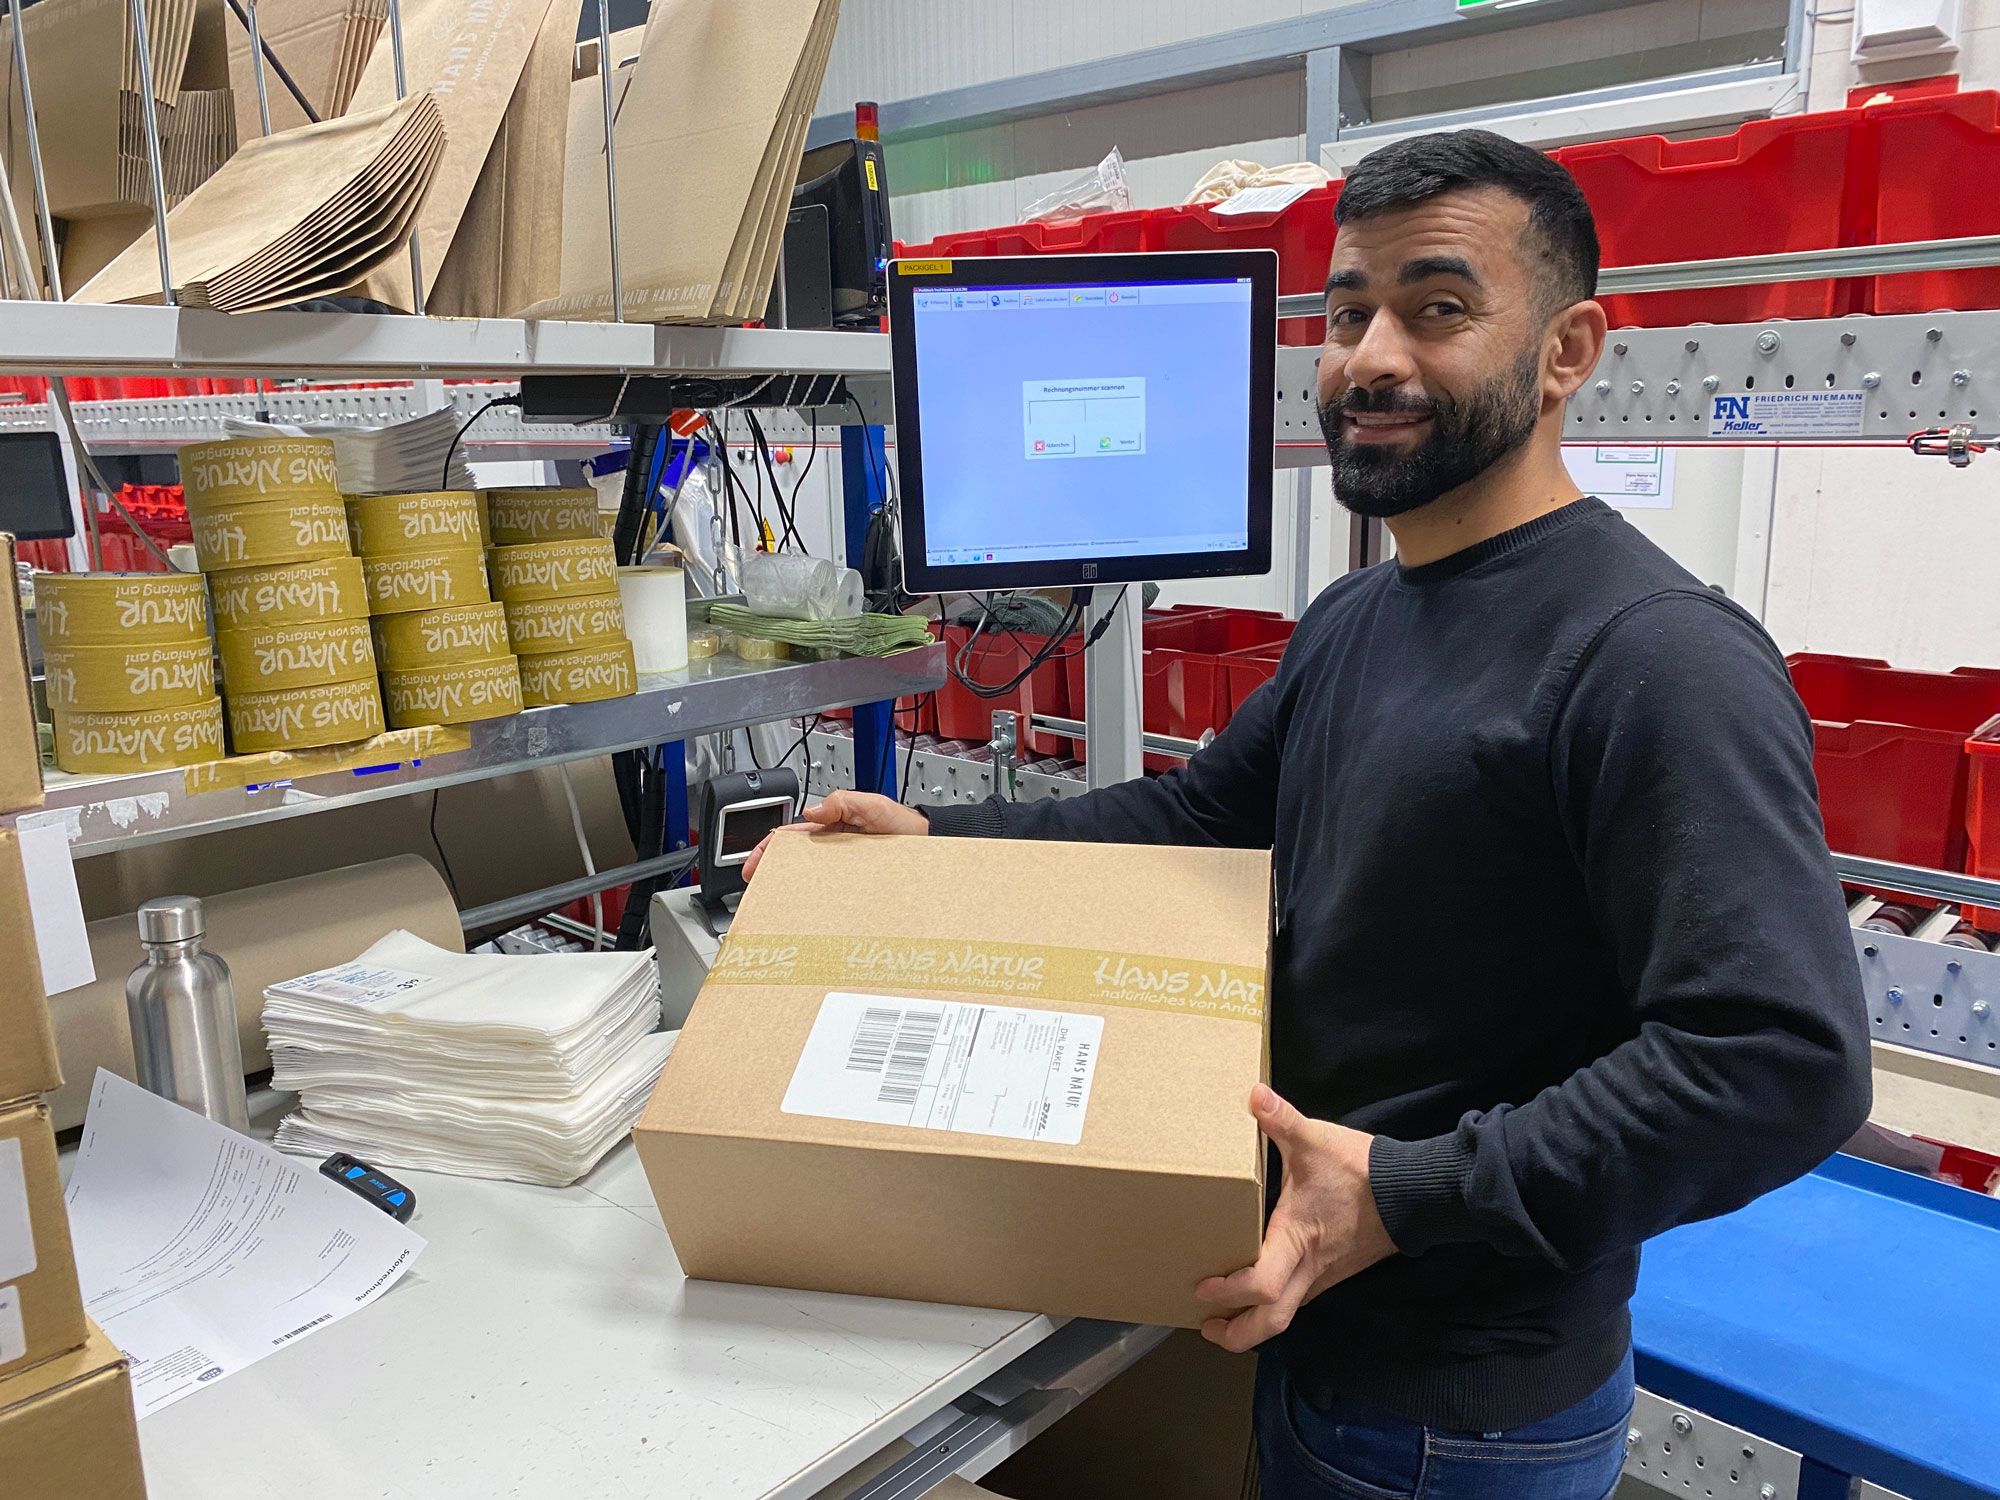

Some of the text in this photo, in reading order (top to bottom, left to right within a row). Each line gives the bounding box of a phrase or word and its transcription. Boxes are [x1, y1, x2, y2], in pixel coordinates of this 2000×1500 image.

[652, 287, 680, 303] HANS
[680, 284, 710, 302] NATUR
[1713, 396, 1751, 420] FN
[1755, 393, 1863, 403] FRIEDRICH NIEMANN
[1723, 421, 1763, 431] Keller
[207, 447, 256, 461] Anfang
[192, 457, 282, 494] NATUR
[400, 509, 473, 542] NATUR
[511, 550, 551, 562] Anfang
[376, 570, 456, 603] HANS
[499, 559, 571, 591] NATUR
[116, 595, 202, 632] NATUR
[256, 581, 343, 616] HANS
[524, 604, 565, 616] Anfang
[442, 610, 483, 624] Anfang
[510, 612, 586, 645] NATUR
[152, 646, 196, 661] Anfang
[276, 630, 326, 645] Anfang
[421, 621, 498, 653] NATUR
[255, 638, 348, 676] NATUR
[126, 661, 210, 696] NATUR
[568, 662, 631, 693] HANS
[311, 694, 380, 730] HANS
[390, 682, 464, 717] NATUR
[87, 714, 141, 728] Anfang
[69, 727, 167, 764] NATUR
[847, 939, 937, 971] HANS
[938, 945, 1045, 979] NATUR
[1092, 954, 1190, 994] HANS
[932, 975, 958, 986] von
[960, 974, 1016, 991] Anfang
[1188, 997, 1218, 1011] von
[1051, 1027, 1069, 1073] DHL PAKET
[1065, 1043, 1091, 1108] HANS NATUR
[1034, 1102, 1051, 1132] DHL
[354, 1248, 411, 1302] Sofortrechnung
